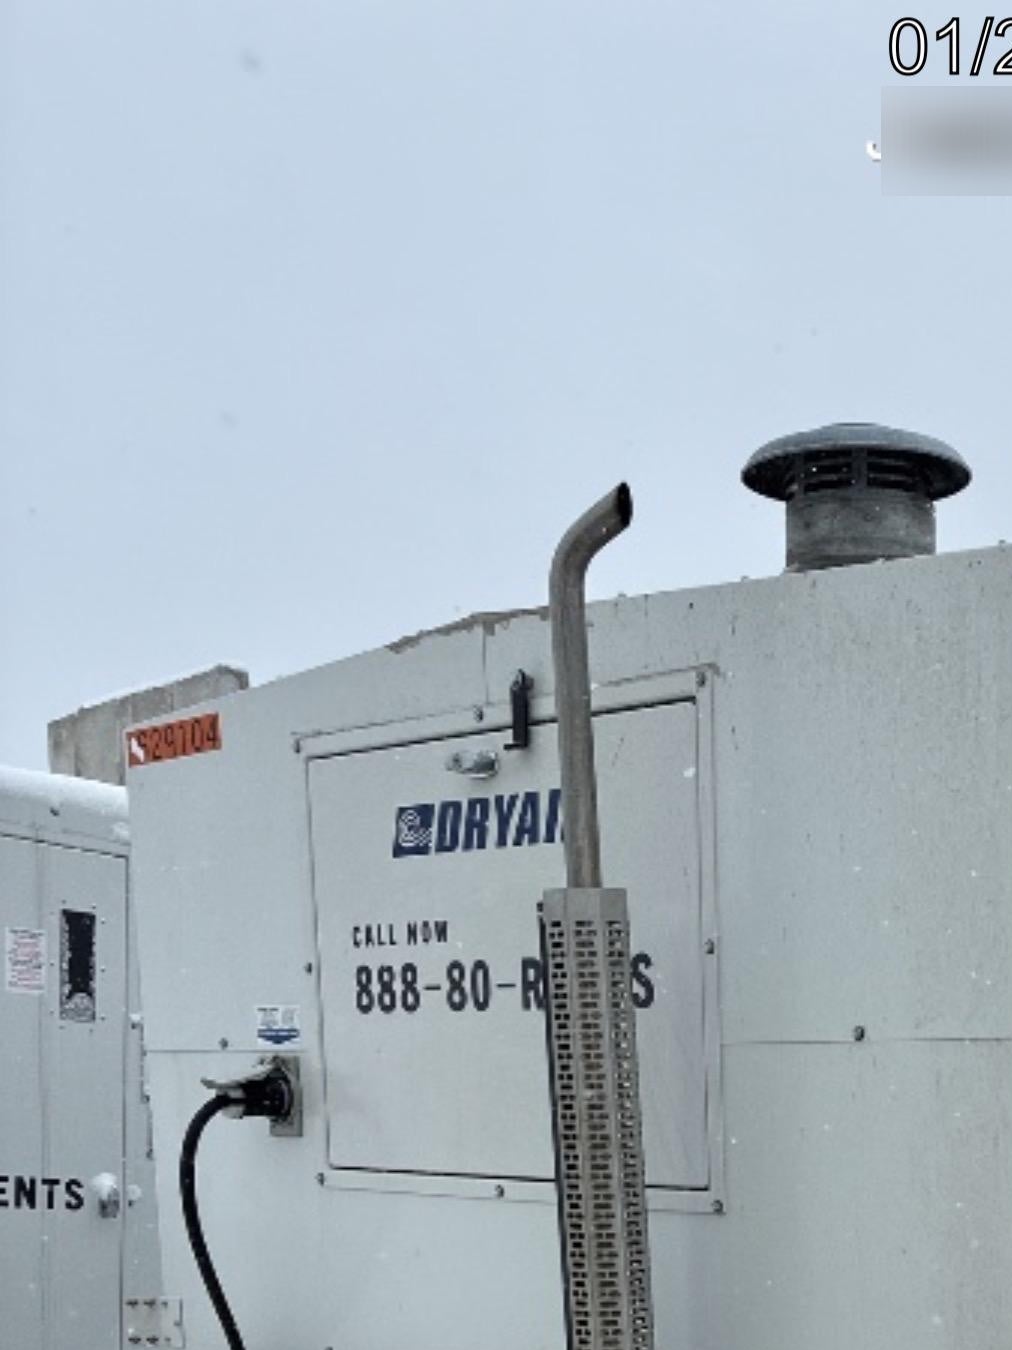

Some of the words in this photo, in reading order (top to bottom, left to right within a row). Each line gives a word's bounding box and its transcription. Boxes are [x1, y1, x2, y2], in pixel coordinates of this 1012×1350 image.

[434, 788, 566, 853] DRYAI
[353, 923, 398, 948] CALL
[407, 920, 449, 945] NOW
[355, 952, 655, 1015] 888-80-RS
